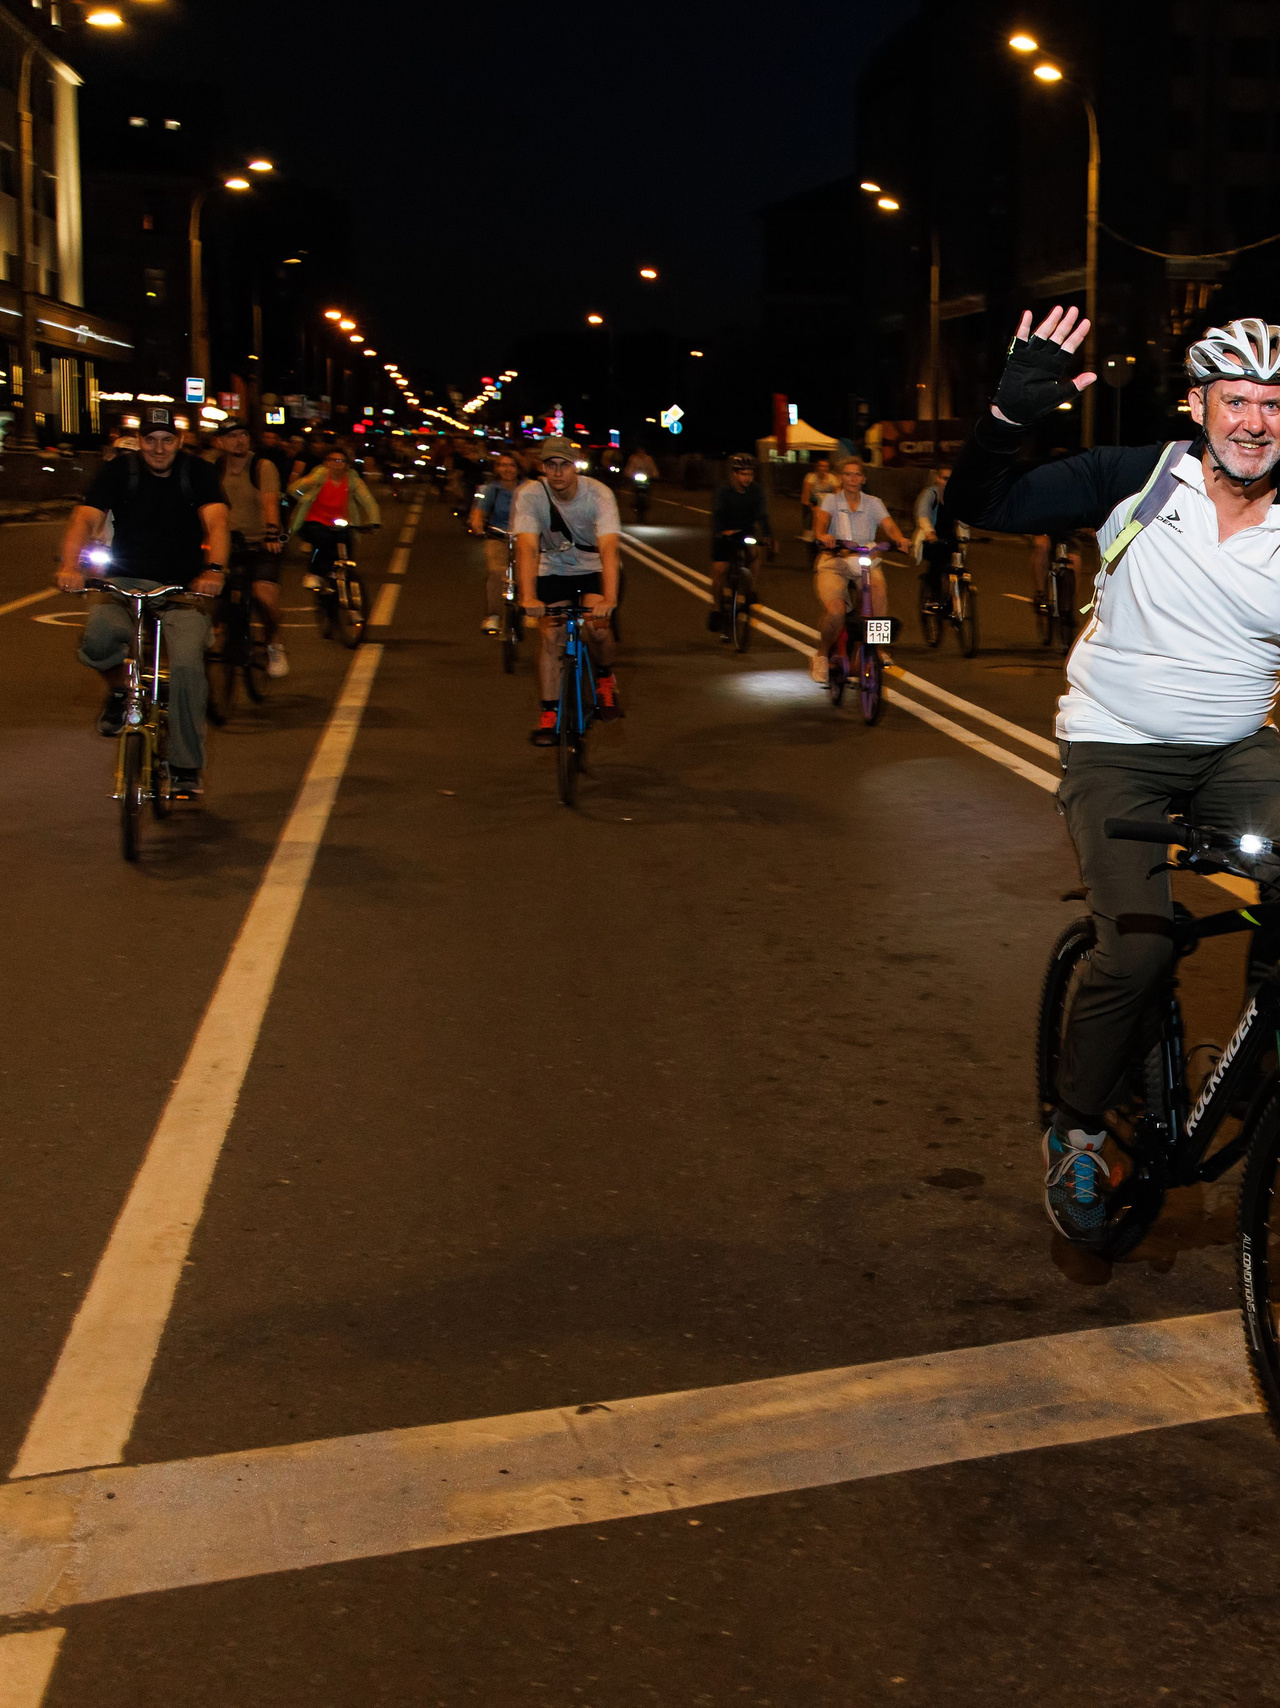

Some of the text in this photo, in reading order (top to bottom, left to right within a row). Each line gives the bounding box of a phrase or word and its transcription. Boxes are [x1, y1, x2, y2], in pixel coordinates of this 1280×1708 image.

[1156, 515, 1183, 534] DEMIX
[869, 632, 890, 642] 11H
[1185, 996, 1259, 1138] ROCKRIDER
[1242, 1232, 1256, 1314] ALL CONDITIONS
